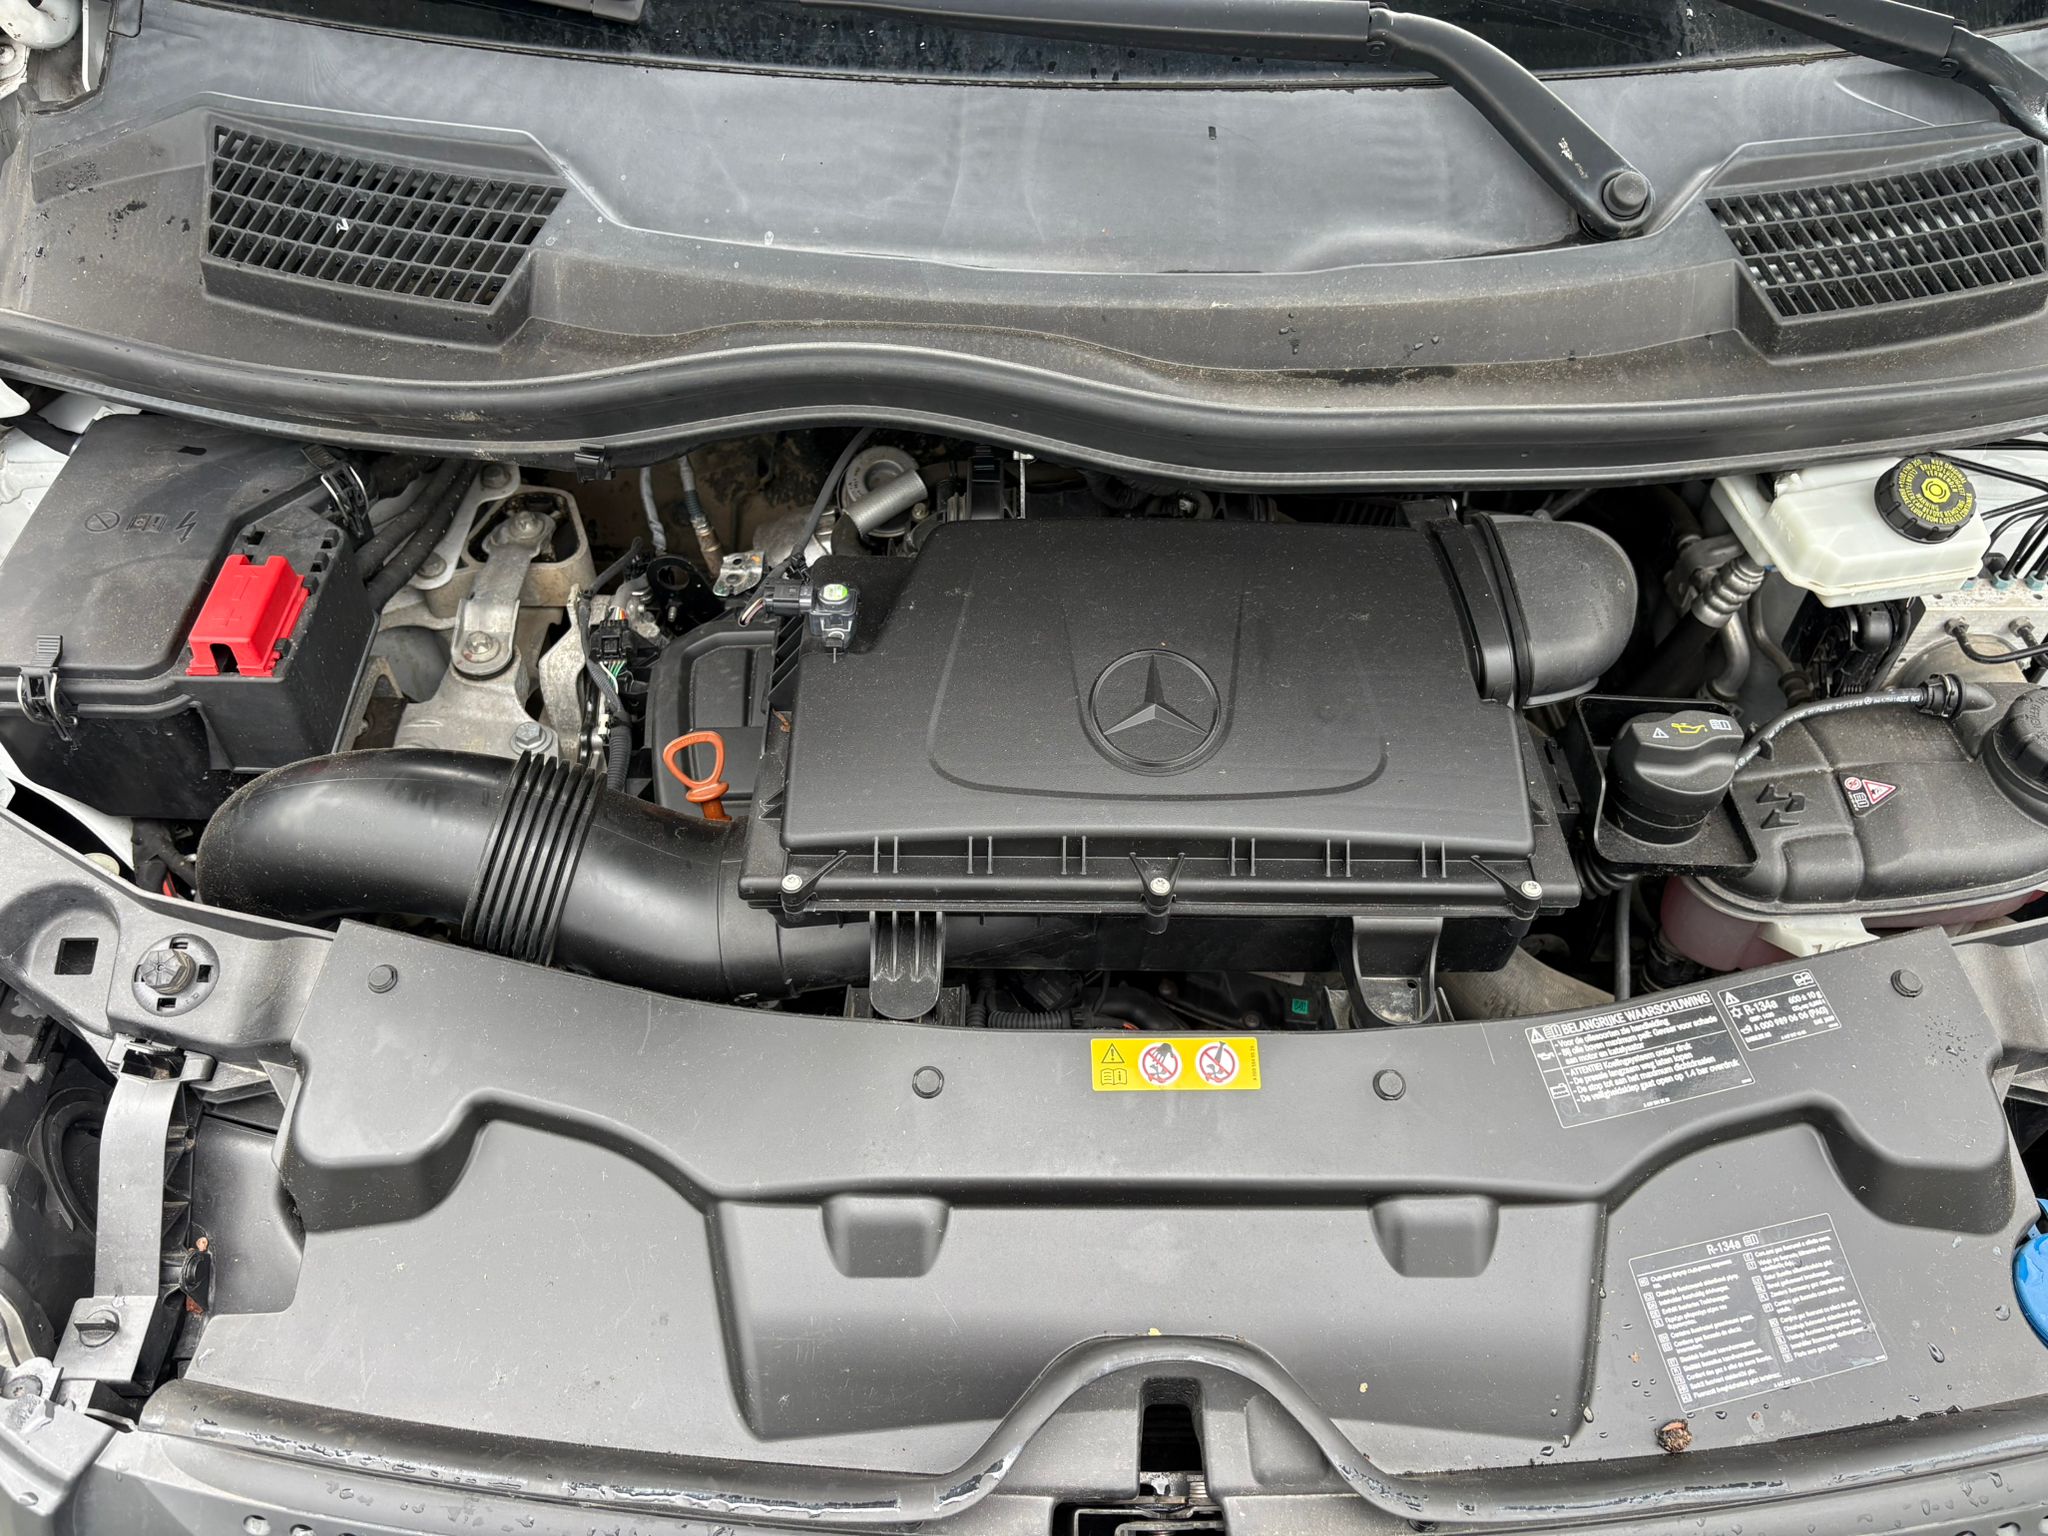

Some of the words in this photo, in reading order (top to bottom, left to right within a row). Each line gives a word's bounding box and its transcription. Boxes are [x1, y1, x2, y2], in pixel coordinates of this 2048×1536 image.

[1562, 1012, 1625, 1035] BELANGRIJKE
[1624, 993, 1710, 1021] WAARSCHUWING
[1743, 1000, 1778, 1015] R-134a
[1807, 991, 1816, 999] 10
[1707, 1240, 1741, 1255] R-134a
